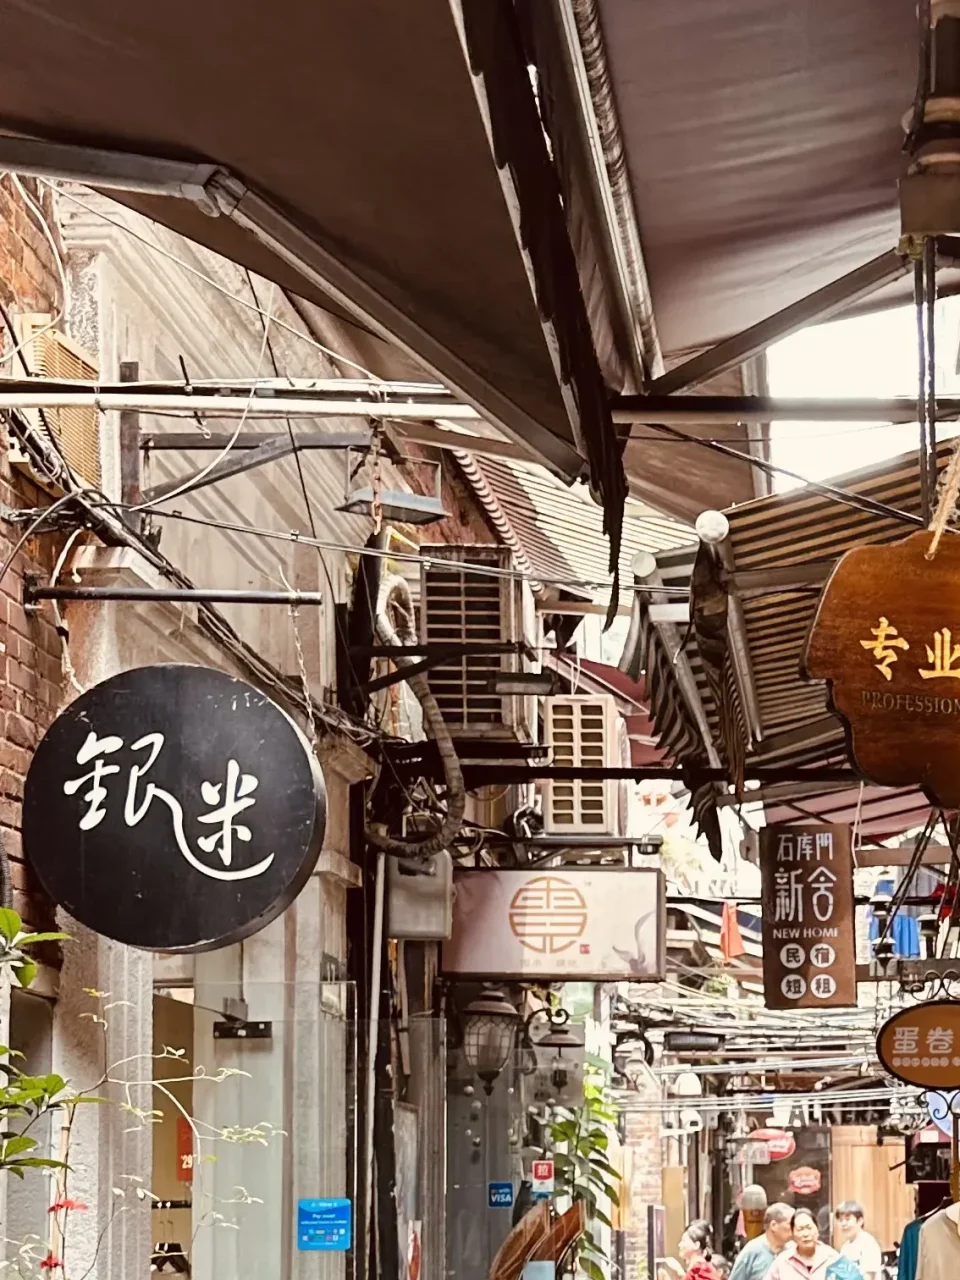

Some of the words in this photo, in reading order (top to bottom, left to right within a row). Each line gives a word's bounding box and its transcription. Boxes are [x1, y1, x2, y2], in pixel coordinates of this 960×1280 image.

[774, 866, 837, 923] 新舍
[772, 928, 801, 939] NEW
[783, 946, 832, 965] 民宿
[783, 977, 833, 995] 短租
[490, 1194, 512, 1203] VISA
